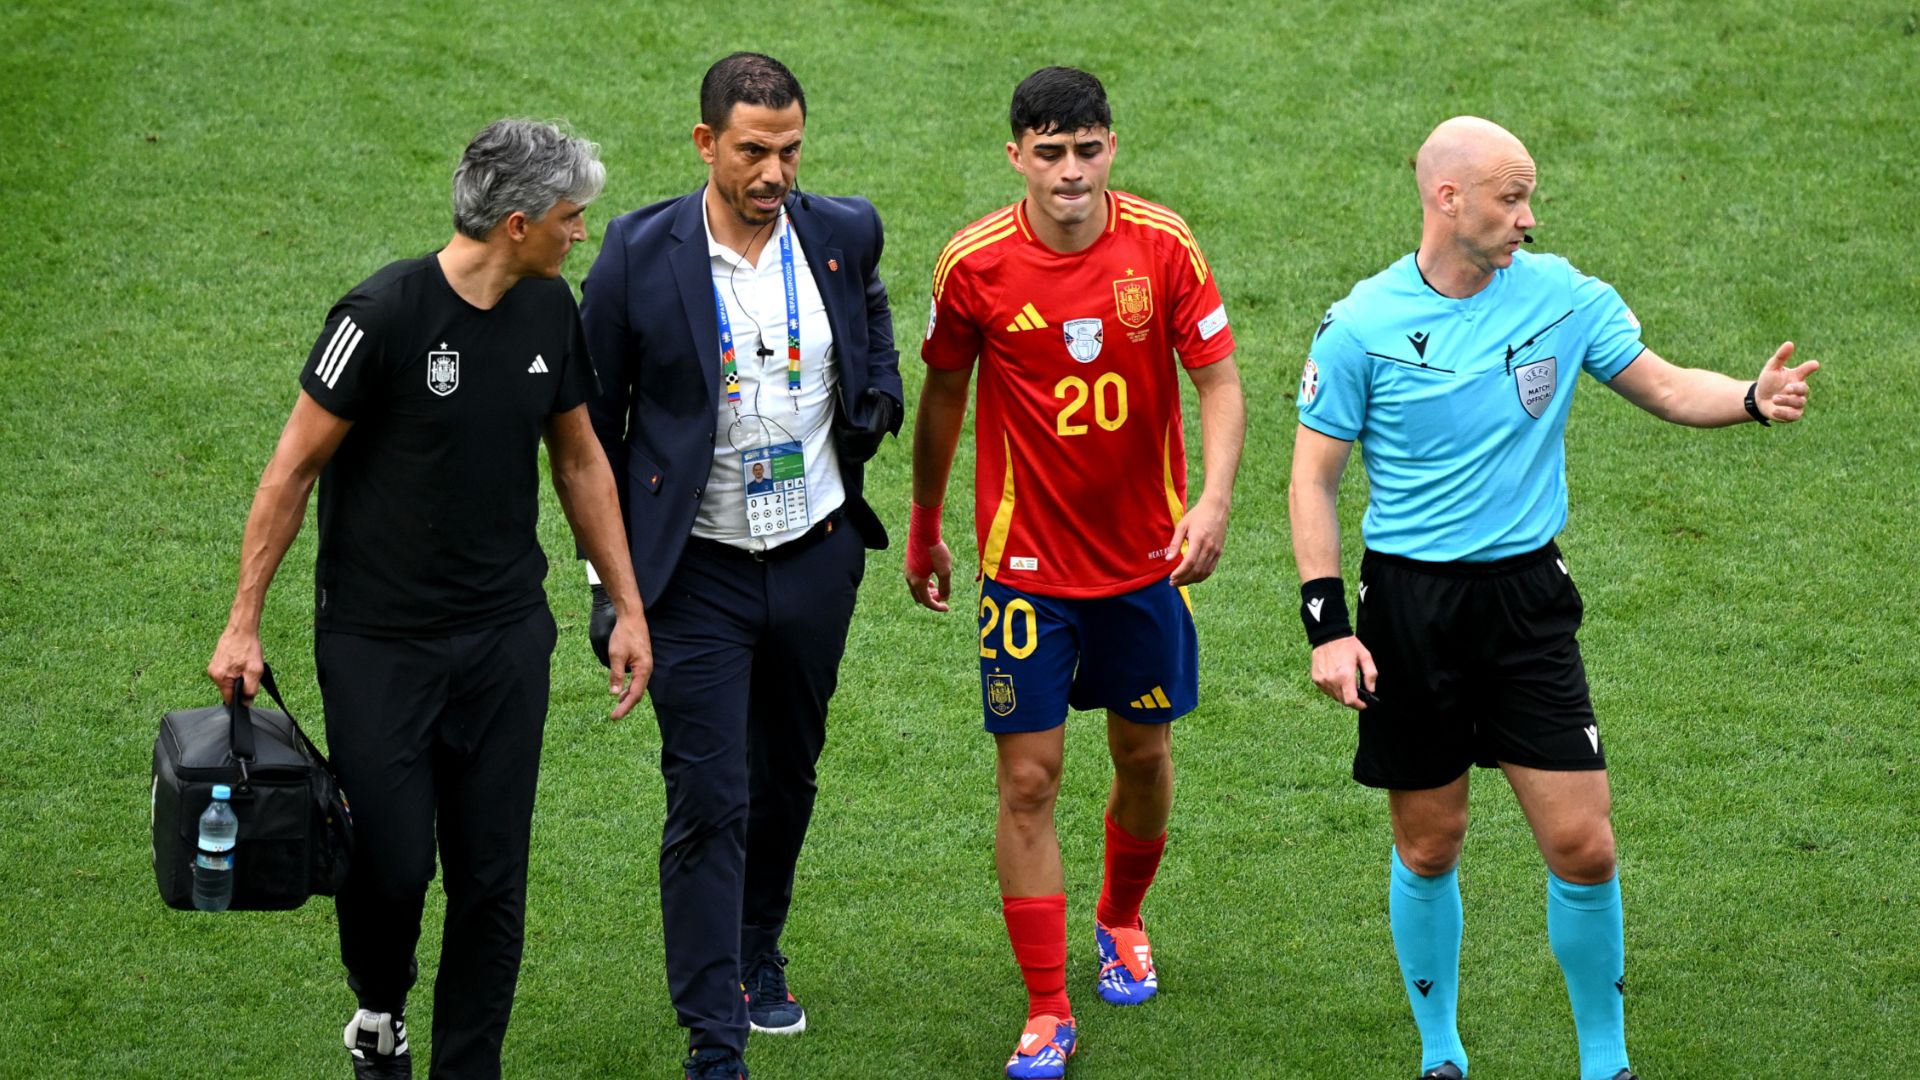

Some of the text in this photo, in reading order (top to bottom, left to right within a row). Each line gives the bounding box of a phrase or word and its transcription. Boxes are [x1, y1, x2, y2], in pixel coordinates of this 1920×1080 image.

[1525, 368, 1549, 382] UEFA
[1528, 384, 1550, 396] MATCH
[1054, 371, 1128, 436] 20
[1526, 391, 1552, 406] OFFICIAL
[751, 494, 782, 508] 0 1 2
[979, 595, 1038, 659] 20
